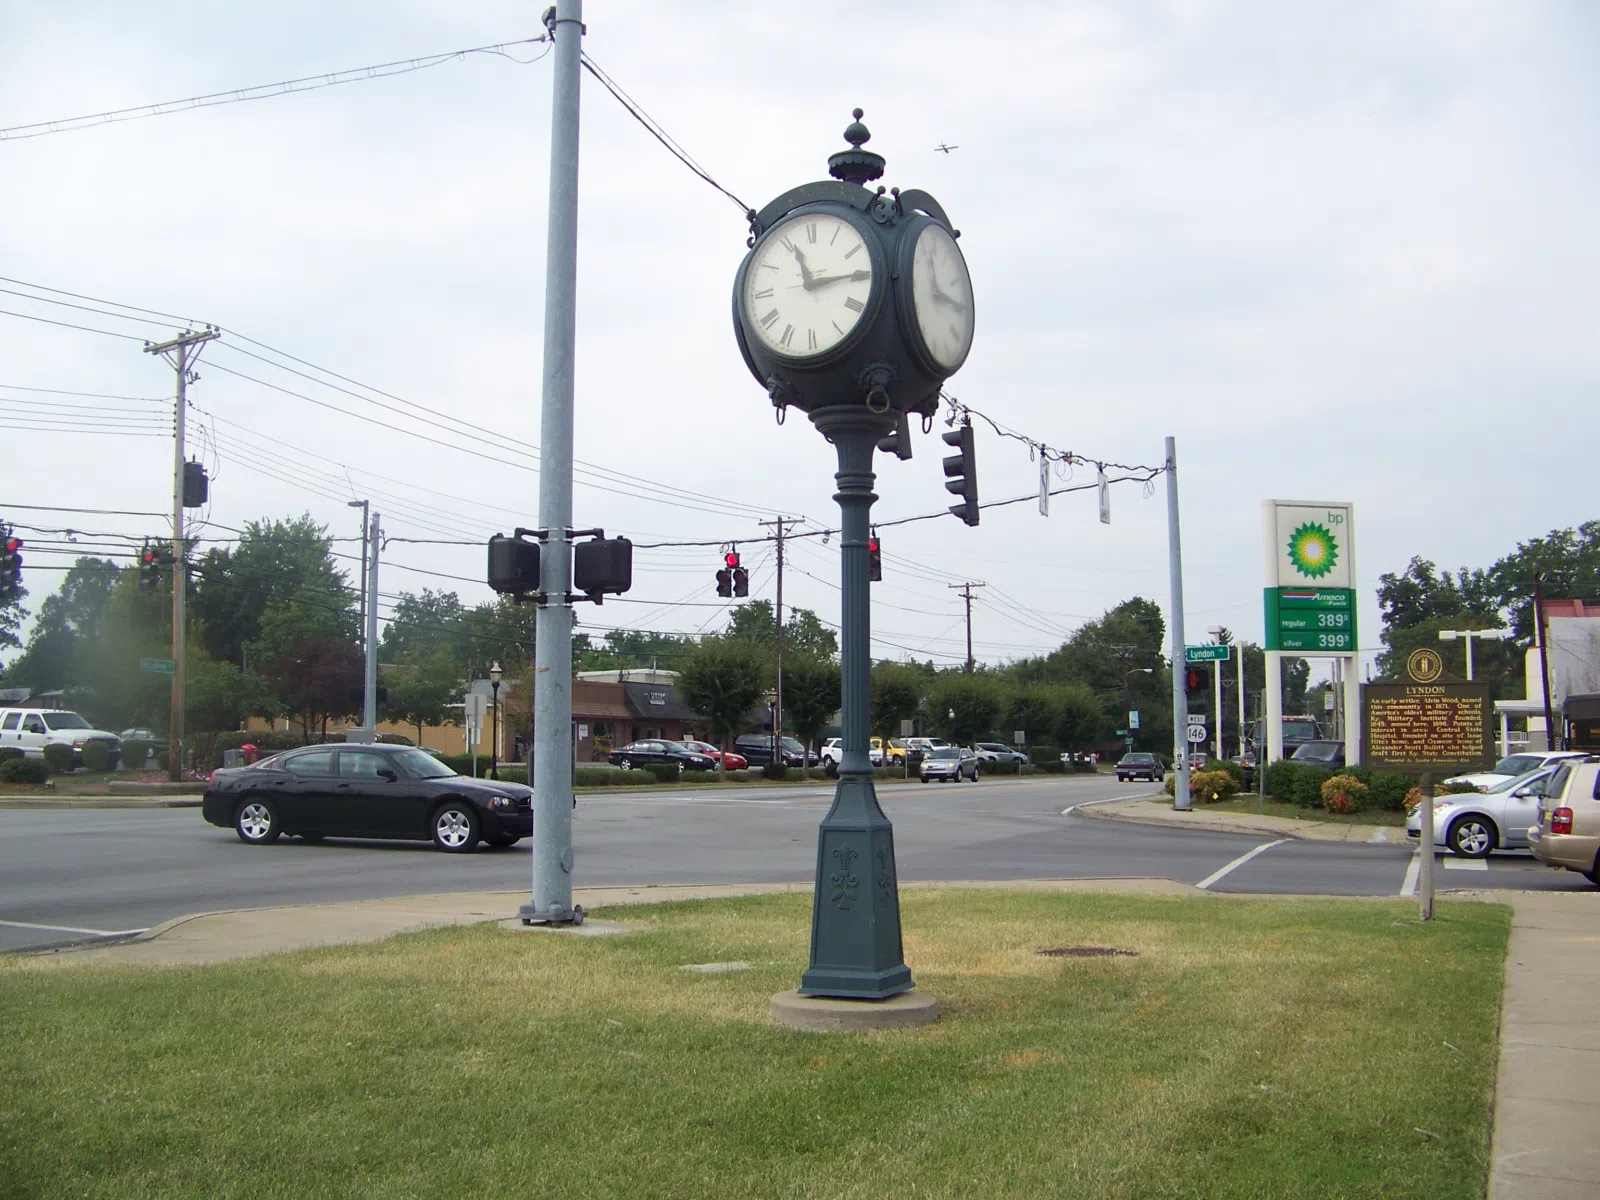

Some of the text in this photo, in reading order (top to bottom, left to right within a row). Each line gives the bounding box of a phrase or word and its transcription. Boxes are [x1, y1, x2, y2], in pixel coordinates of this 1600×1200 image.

[1328, 511, 1344, 526] bp
[1312, 592, 1346, 601] Amoco
[1282, 619, 1306, 628] regular
[1190, 650, 1215, 659] Lyndon
[1406, 686, 1445, 695] LYNDON
[1188, 728, 1204, 739] 146
